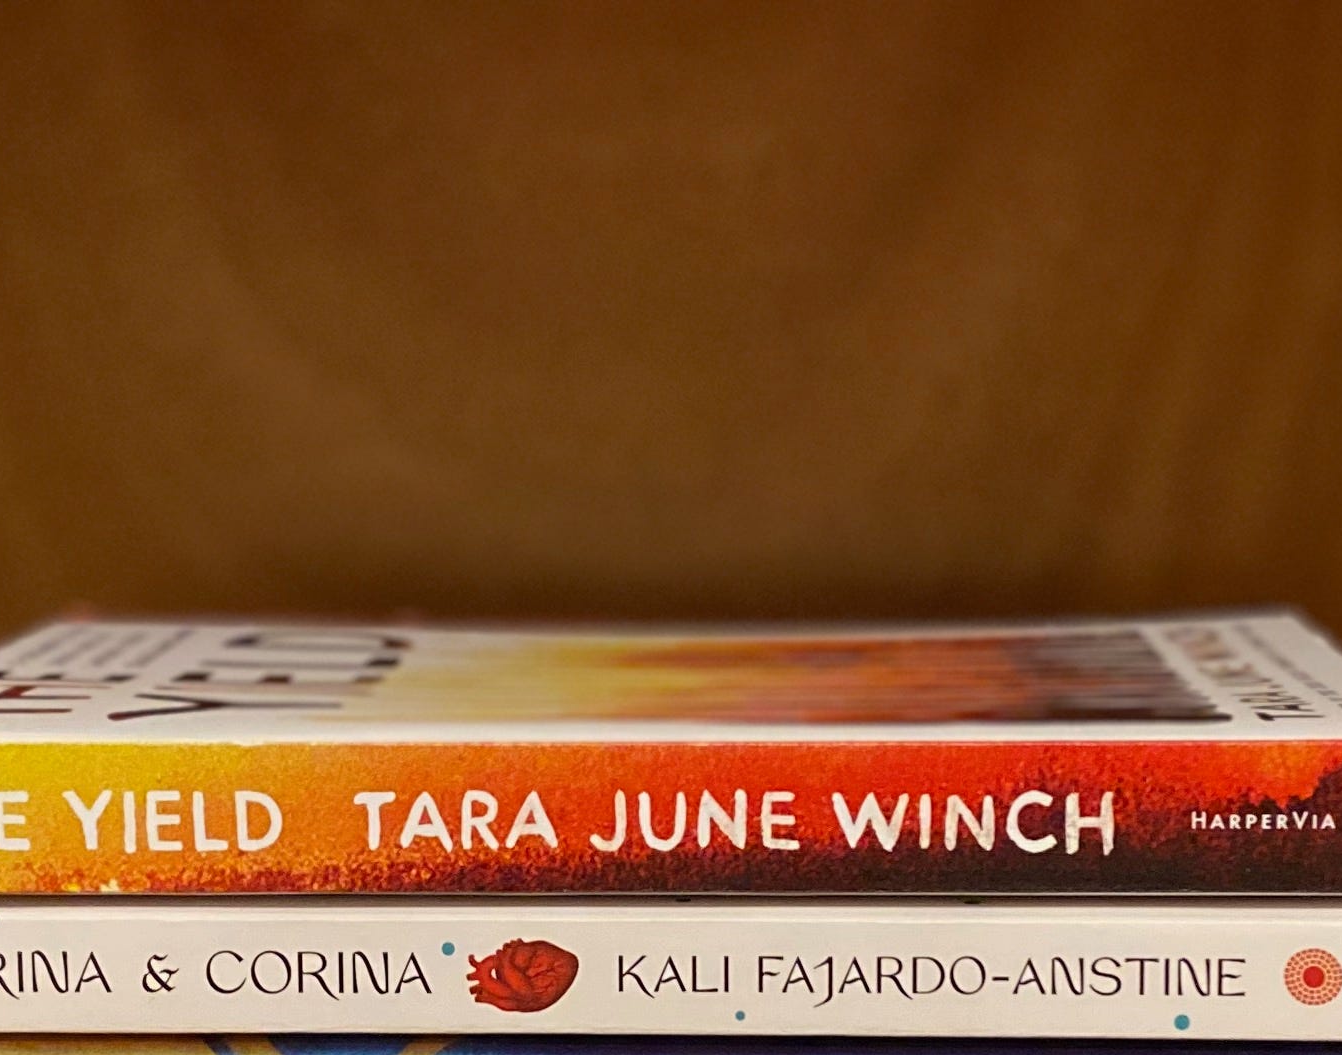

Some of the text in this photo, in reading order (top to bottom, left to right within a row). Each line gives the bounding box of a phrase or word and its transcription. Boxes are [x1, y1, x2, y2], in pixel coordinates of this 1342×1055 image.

[62, 789, 283, 853] YIELD
[353, 790, 558, 852] TARA
[590, 789, 799, 853] JUNE
[831, 790, 1115, 855] WINCH
[141, 954, 180, 993] &
[205, 949, 433, 1000] CORINA
[616, 954, 730, 998] KALI
[757, 955, 1247, 1007] FAJARDO-ANSTINE
